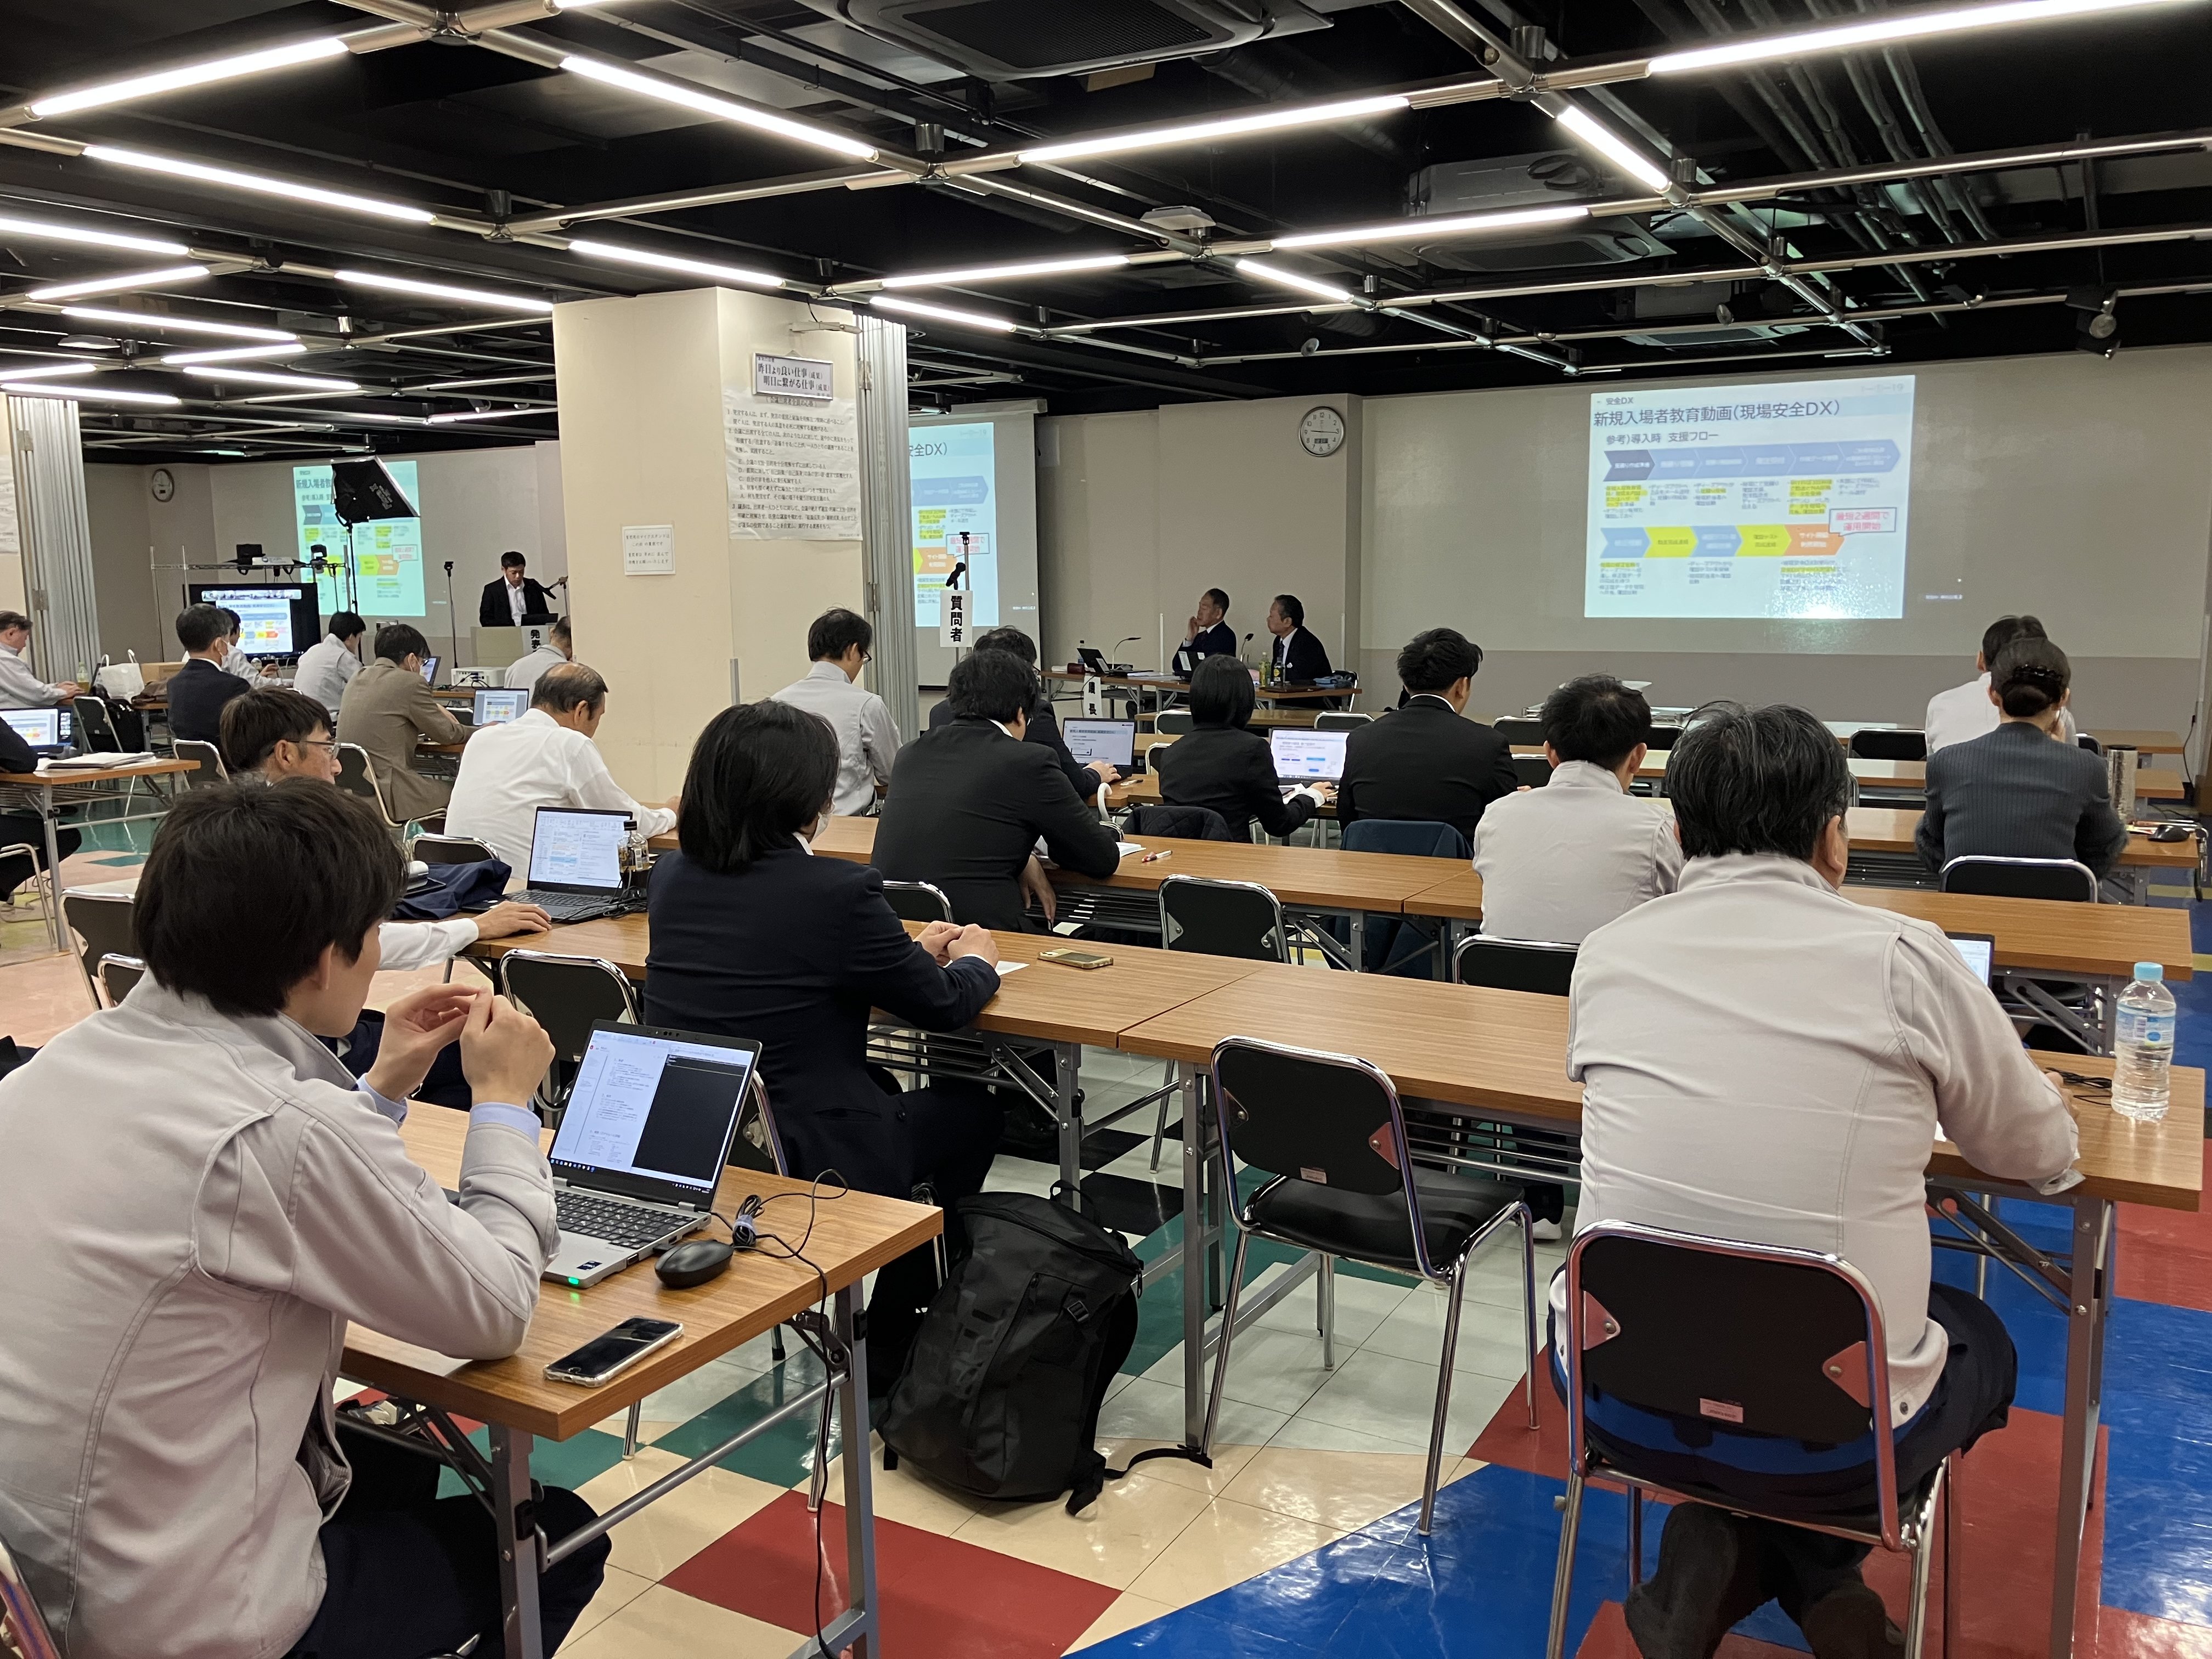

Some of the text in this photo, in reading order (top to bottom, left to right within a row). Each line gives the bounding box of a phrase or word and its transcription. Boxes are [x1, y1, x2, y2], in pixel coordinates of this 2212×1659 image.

[1606, 397, 1634, 405] 安全DX
[1593, 399, 1840, 427] 新規入場者教育動画(現場安全DX)
[1668, 431, 1719, 442] 支援フロー
[950, 596, 962, 642] 質問者
[531, 629, 541, 652] 発表
